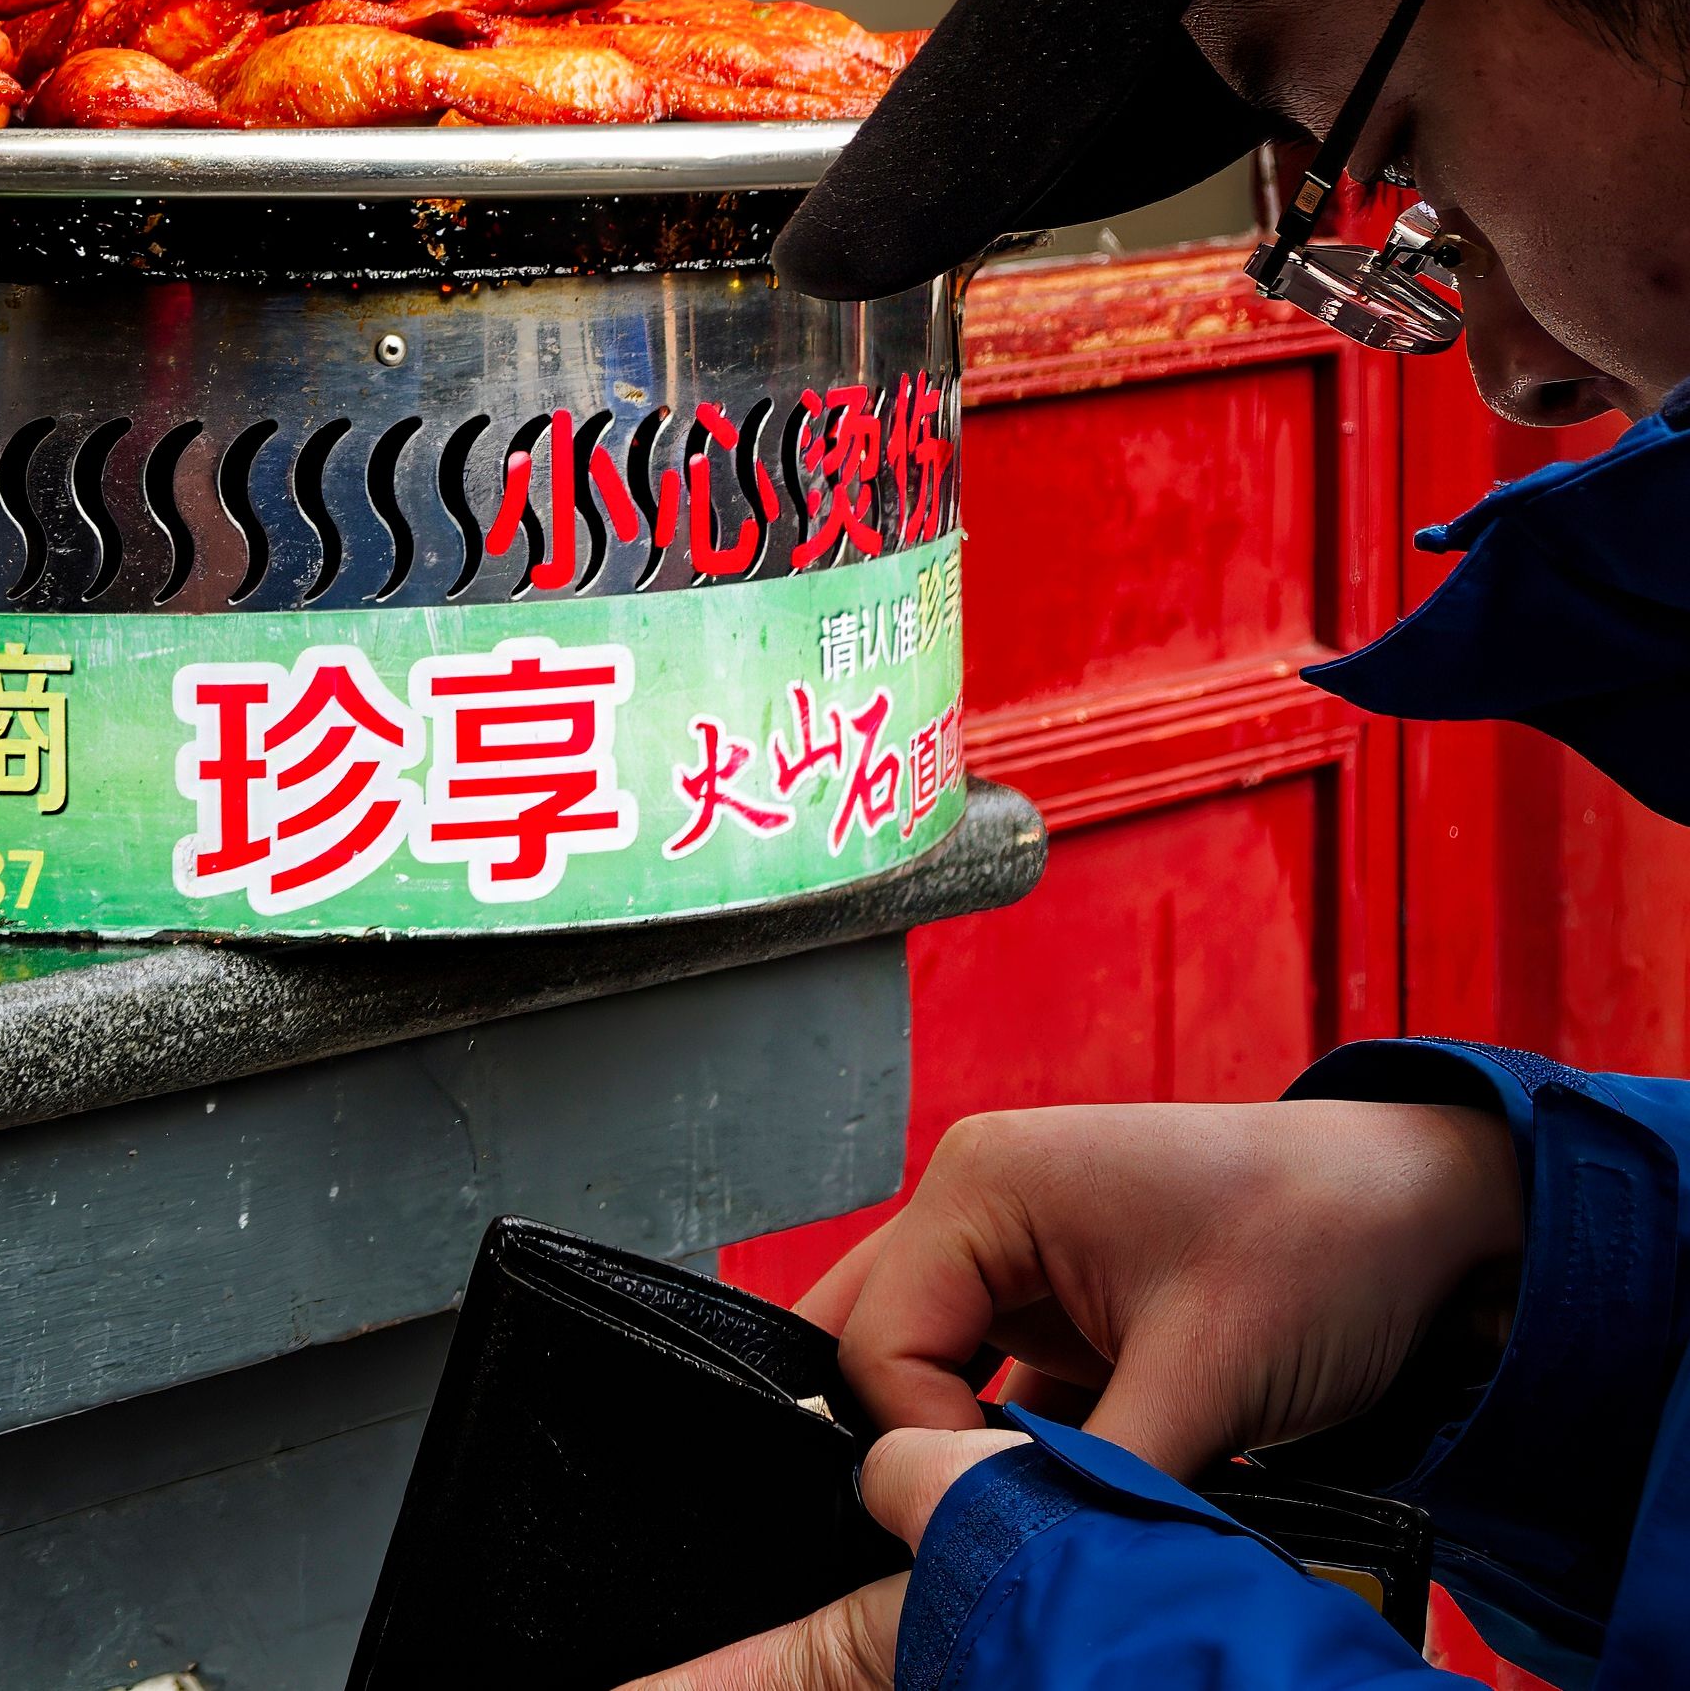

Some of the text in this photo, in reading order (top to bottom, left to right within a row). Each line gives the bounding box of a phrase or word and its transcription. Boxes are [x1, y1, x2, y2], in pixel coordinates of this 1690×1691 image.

[485, 368, 954, 590] 小心烫伤
[194, 657, 620, 896] 珍享
